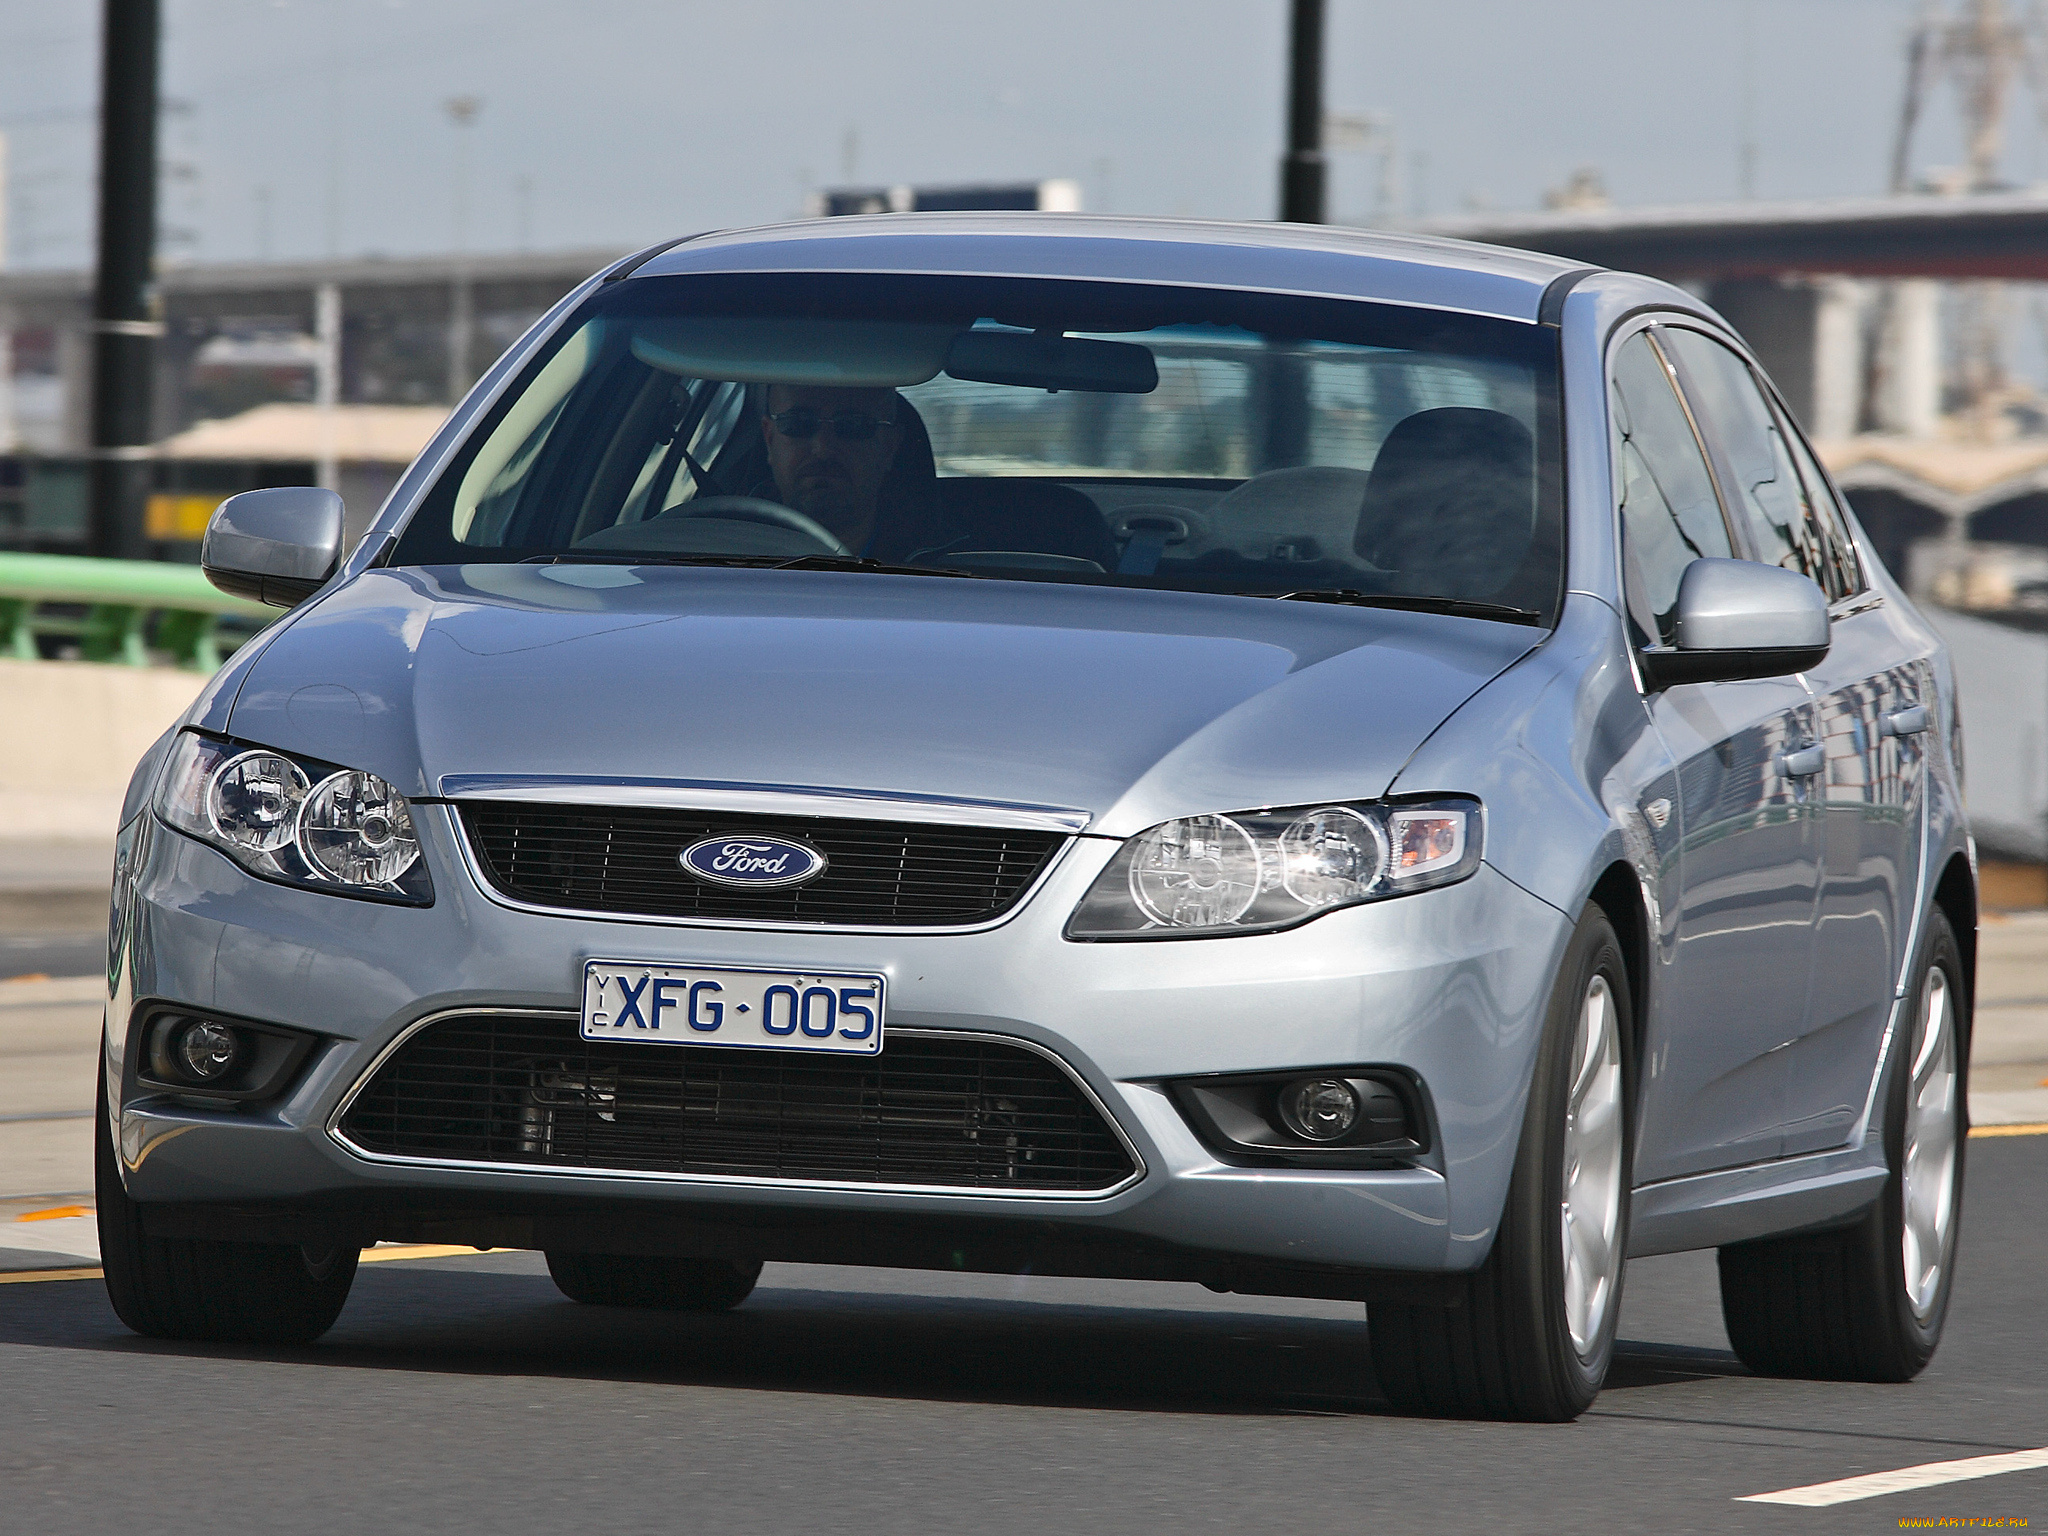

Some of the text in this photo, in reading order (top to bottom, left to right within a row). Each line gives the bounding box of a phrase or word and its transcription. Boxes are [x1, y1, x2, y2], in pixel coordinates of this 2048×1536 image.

[712, 843, 790, 874] Ford
[613, 976, 875, 1039] XFG 005
